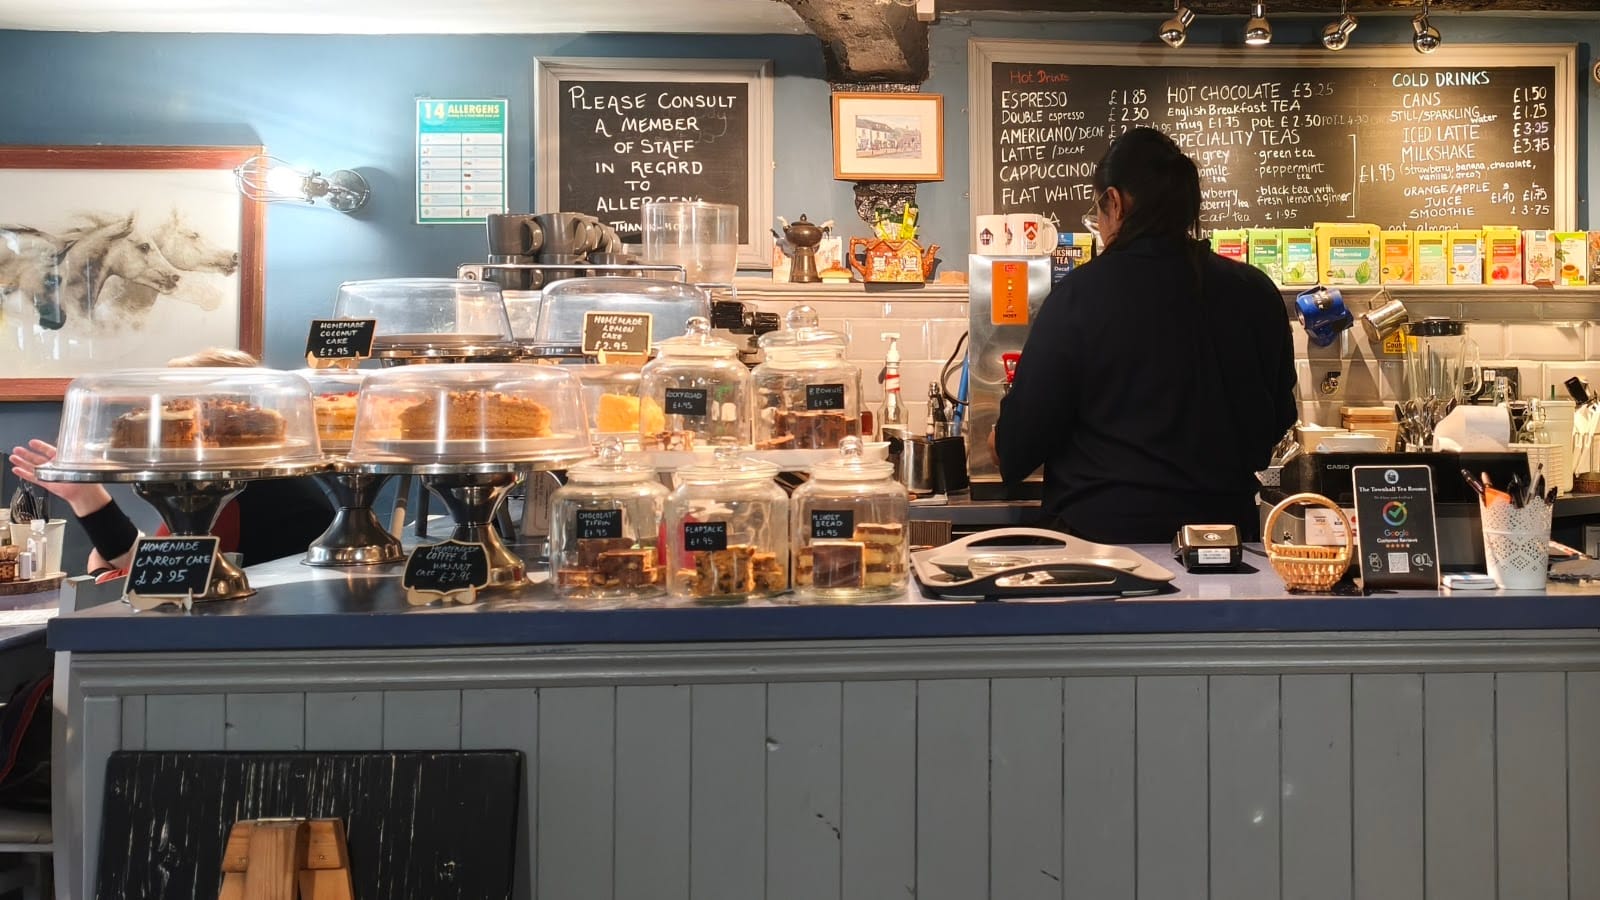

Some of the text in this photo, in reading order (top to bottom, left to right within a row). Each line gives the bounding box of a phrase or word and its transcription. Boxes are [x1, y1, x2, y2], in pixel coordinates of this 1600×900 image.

[1392, 70, 1490, 88] COLD DRINKS
[1001, 90, 1068, 109] ESPRESSO
[1167, 85, 1197, 104] HOT
[1200, 83, 1281, 101] CHOCOLATE
[1402, 92, 1441, 109] CANS
[423, 102, 500, 120] 14 ALLERGENS
[1001, 110, 1086, 125] DOUBLE espresso
[1167, 99, 1301, 121] English Breakfast TEA
[1390, 106, 1480, 122] STILL/SPARKLING
[594, 116, 700, 137] A MEMBER
[1175, 120, 1204, 132] mug
[1251, 115, 1275, 131] pot
[1470, 114, 1498, 123] water
[1169, 129, 1301, 147] SPECIALITY TEAS
[1402, 125, 1481, 145] ICED LATTE
[614, 139, 696, 159] OF STAFF
[1001, 145, 1047, 163] LATTE
[1259, 148, 1317, 165] green tea
[1401, 143, 1477, 163] MILKSHAKE
[1203, 149, 1230, 167] grey
[595, 161, 703, 178] IN REGARD
[1259, 163, 1326, 179] peppermint
[624, 180, 650, 191] TO
[1260, 183, 1335, 196] black tea with
[1404, 182, 1490, 197] ORANGE/APPLE
[1002, 185, 1041, 206] FLAT
[1257, 195, 1283, 207] fresh
[1424, 195, 1462, 209] JUICE
[1232, 211, 1251, 222] tea
[1408, 206, 1475, 219] SMOOTHIE
[1051, 248, 1082, 257] RKSHIRE
[1056, 256, 1069, 265] TEA
[593, 315, 644, 326] HOMEMADE
[320, 329, 358, 337] COCONUT
[602, 325, 635, 333] LEMON
[686, 525, 724, 533] FLAPJACK
[1384, 529, 1409, 537] Google
[141, 542, 200, 552] HOMEMADE
[136, 555, 211, 567] CARROT CAKE
